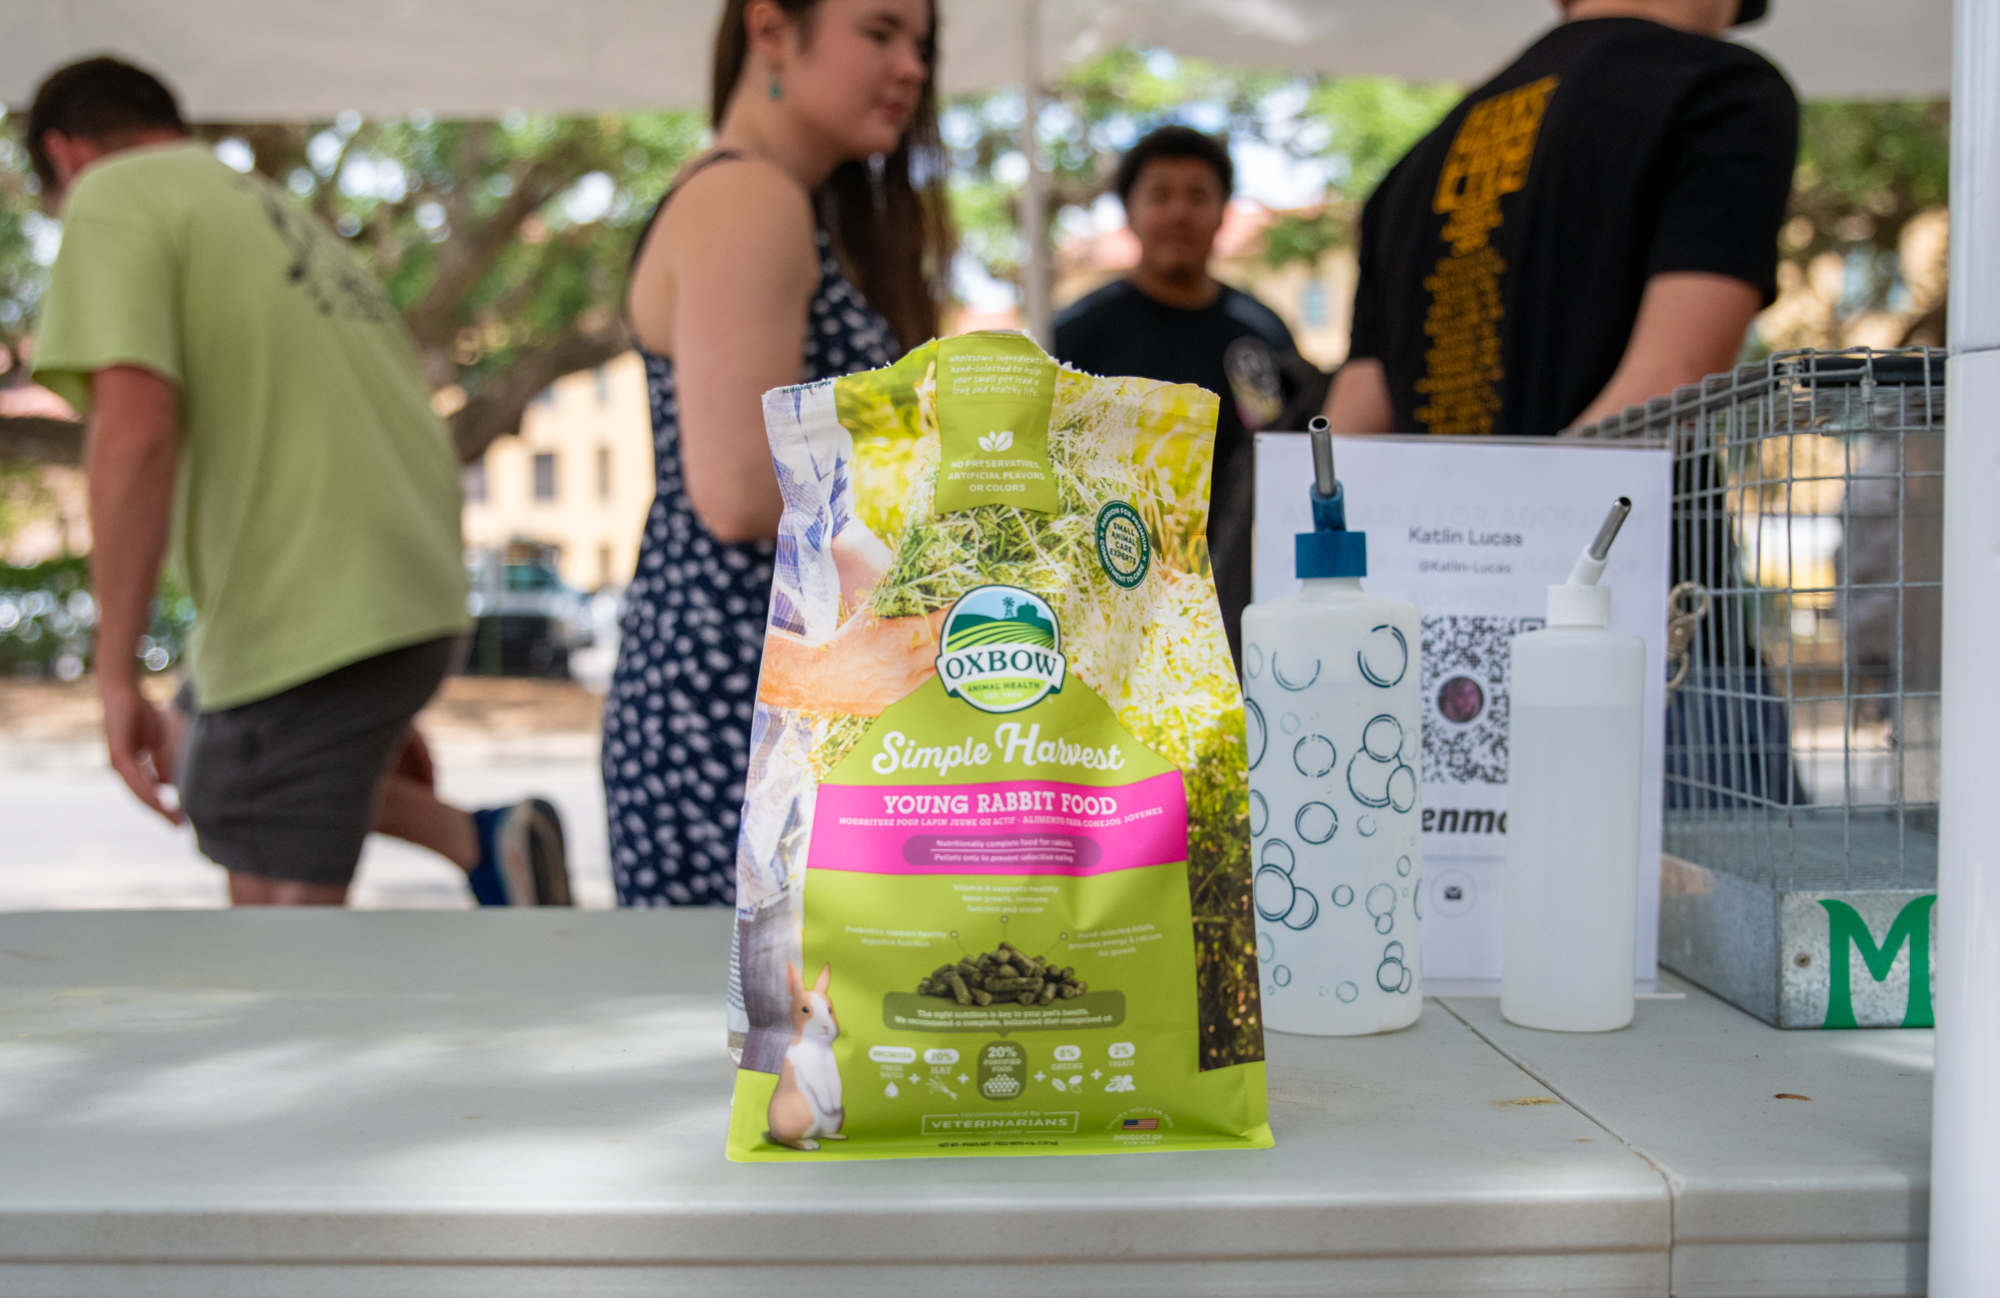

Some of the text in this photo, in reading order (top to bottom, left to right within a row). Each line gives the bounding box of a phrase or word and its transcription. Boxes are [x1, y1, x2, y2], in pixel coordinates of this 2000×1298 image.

[996, 355, 1044, 365] ingredients
[951, 364, 1042, 376] hand-selected to help
[952, 376, 972, 386] your
[974, 375, 996, 384] small
[998, 376, 1012, 386] pet
[1015, 376, 1032, 386] lead
[952, 386, 970, 396] long
[972, 386, 988, 394] and
[990, 385, 1020, 396] healthy
[951, 460, 1042, 470] NO PRESERVATIVES,
[948, 472, 1046, 480] ARTIFICIAL FLAVORS
[969, 484, 1026, 492] OR COLORS
[1102, 507, 1147, 552] PASSION FOR PREMIUM
[1113, 522, 1134, 536] SMALL
[1111, 531, 1136, 546] ANIMAL
[1408, 526, 1524, 547] Katlin Lucas
[1115, 542, 1132, 554] CARE
[1110, 548, 1136, 565] EXPERTS
[1100, 541, 1126, 584] COMMITMENT
[1134, 563, 1146, 580] CARE
[1418, 560, 1512, 574] @Katlin-Lucas
[946, 650, 1056, 680] OXBOW
[968, 681, 1040, 692] ANIMAL HEALTH
[871, 722, 1125, 777] Simple Harvest
[883, 791, 1118, 816] YOUNG RABBIT FOOD
[838, 816, 895, 826] NOURRITURE
[896, 818, 920, 826] POUR
[921, 818, 948, 826] LAPIN
[950, 818, 977, 826] JEUNE
[979, 818, 990, 826] OU
[993, 816, 1016, 826] ACTIF
[1066, 818, 1082, 827] PARA
[1083, 818, 1122, 828] CONEJOS
[1124, 806, 1164, 824] JOVENES
[936, 840, 984, 848] Nutritionally
[986, 840, 1020, 849] complete
[1020, 838, 1038, 846] food
[934, 853, 962, 862] Pellets
[963, 854, 980, 862] only
[990, 855, 1018, 863] prevent
[1020, 854, 1054, 862] selective
[916, 1009, 932, 1018] The
[933, 1010, 954, 1020] right
[954, 1010, 989, 1019] nutrition
[990, 1010, 997, 1018] is
[998, 1010, 1012, 1020] key
[1023, 1010, 1042, 1019] your
[894, 1016, 906, 1024] We
[907, 1018, 954, 1026] recommend
[1003, 1018, 1042, 1026] balanced
[1044, 1016, 1060, 1025] diet
[1060, 1015, 1102, 1025] comprised
[987, 1046, 1018, 1058] 20%
[1050, 1062, 1084, 1071] GREENS
[1108, 1060, 1135, 1068] TREATS
[930, 1066, 953, 1075] HAY
[931, 1118, 1068, 1129] VETERINARIANS
